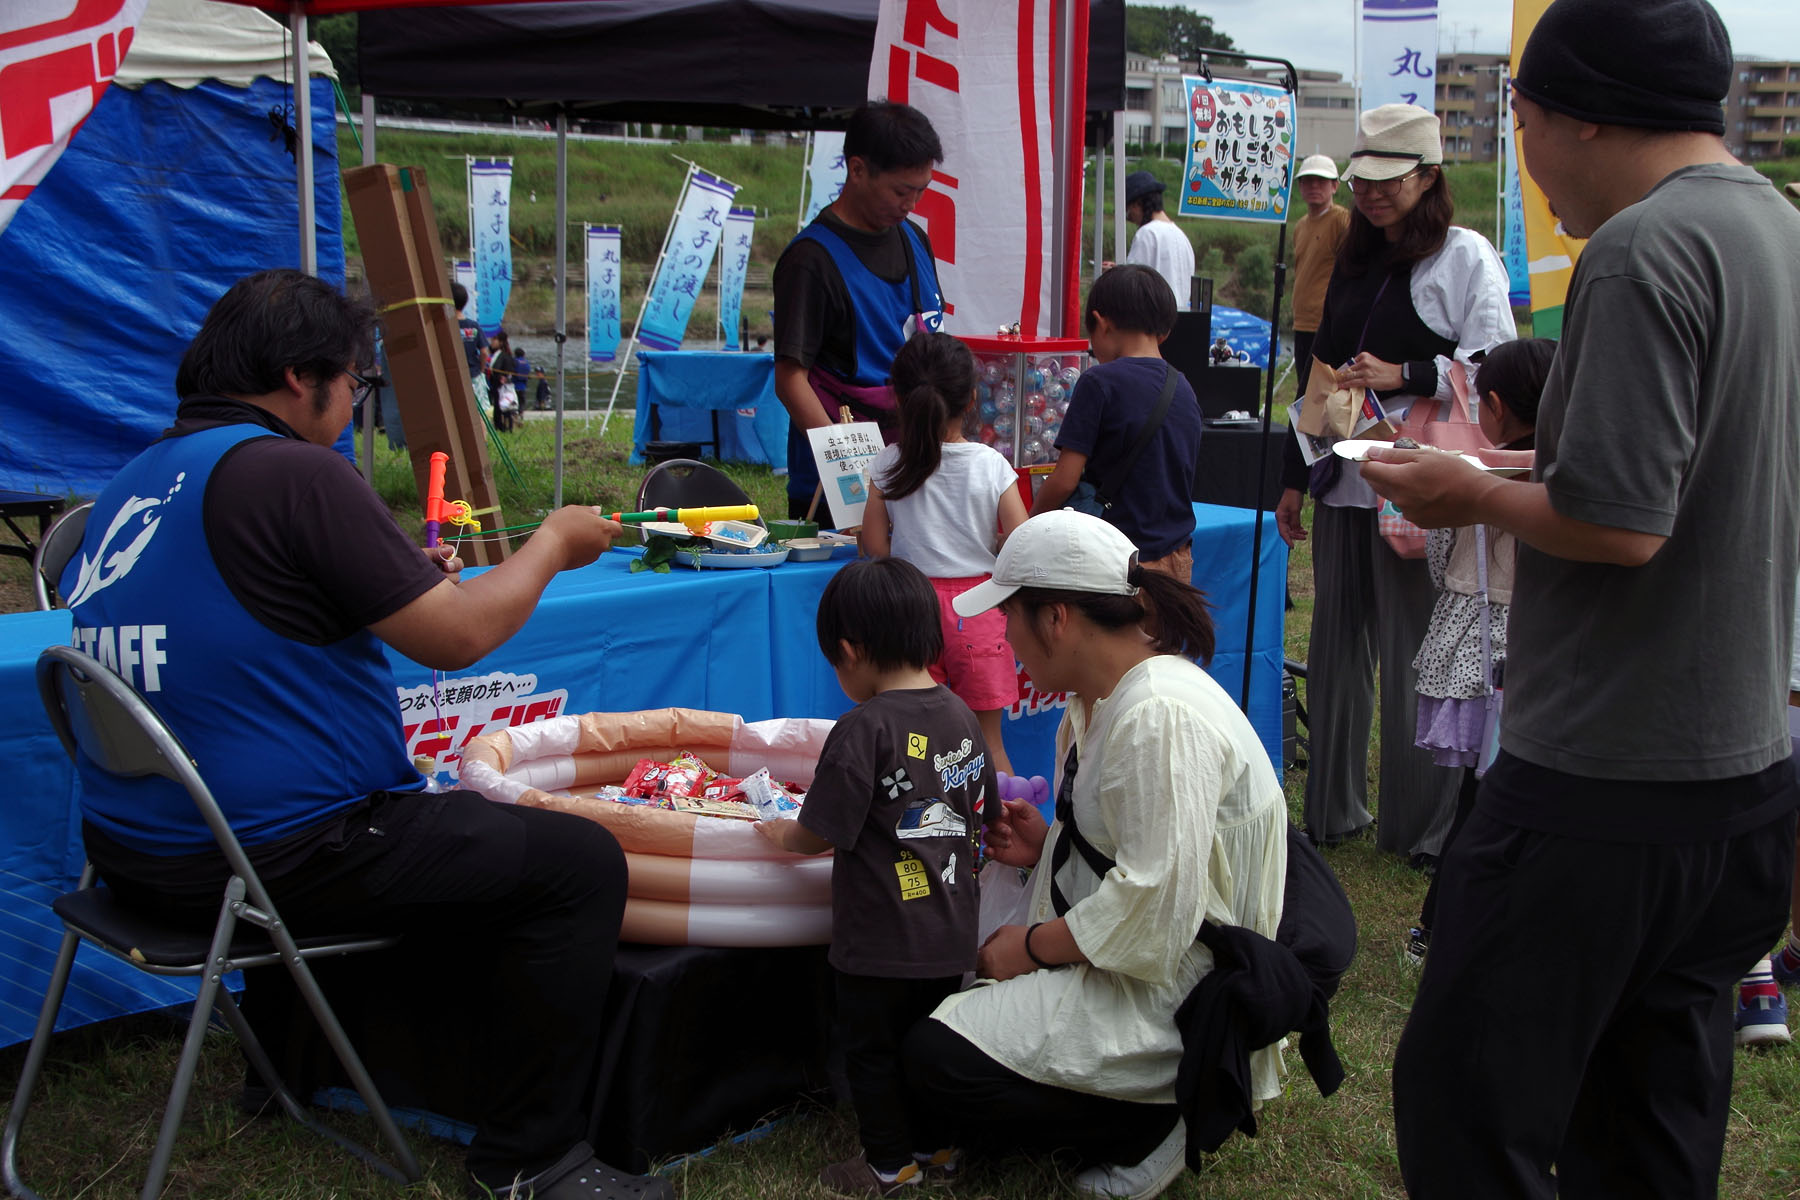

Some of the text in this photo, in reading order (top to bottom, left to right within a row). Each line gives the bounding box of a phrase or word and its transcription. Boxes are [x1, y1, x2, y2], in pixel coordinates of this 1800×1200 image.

[1196, 94, 1209, 106] 1回
[1195, 108, 1212, 121] 無料
[1216, 109, 1276, 140] おもしろ
[1215, 138, 1274, 168] けしごむ
[1220, 165, 1263, 192] ガチャ
[489, 189, 512, 307] 丸子の渡し
[673, 206, 722, 321] 丸子の渡し
[601, 248, 619, 340] 丸子の渡し
[934, 749, 963, 772] Series
[900, 850, 913, 860] 95
[903, 862, 918, 873] 80
[907, 877, 921, 888] 75
[907, 889, 927, 898] R=400
